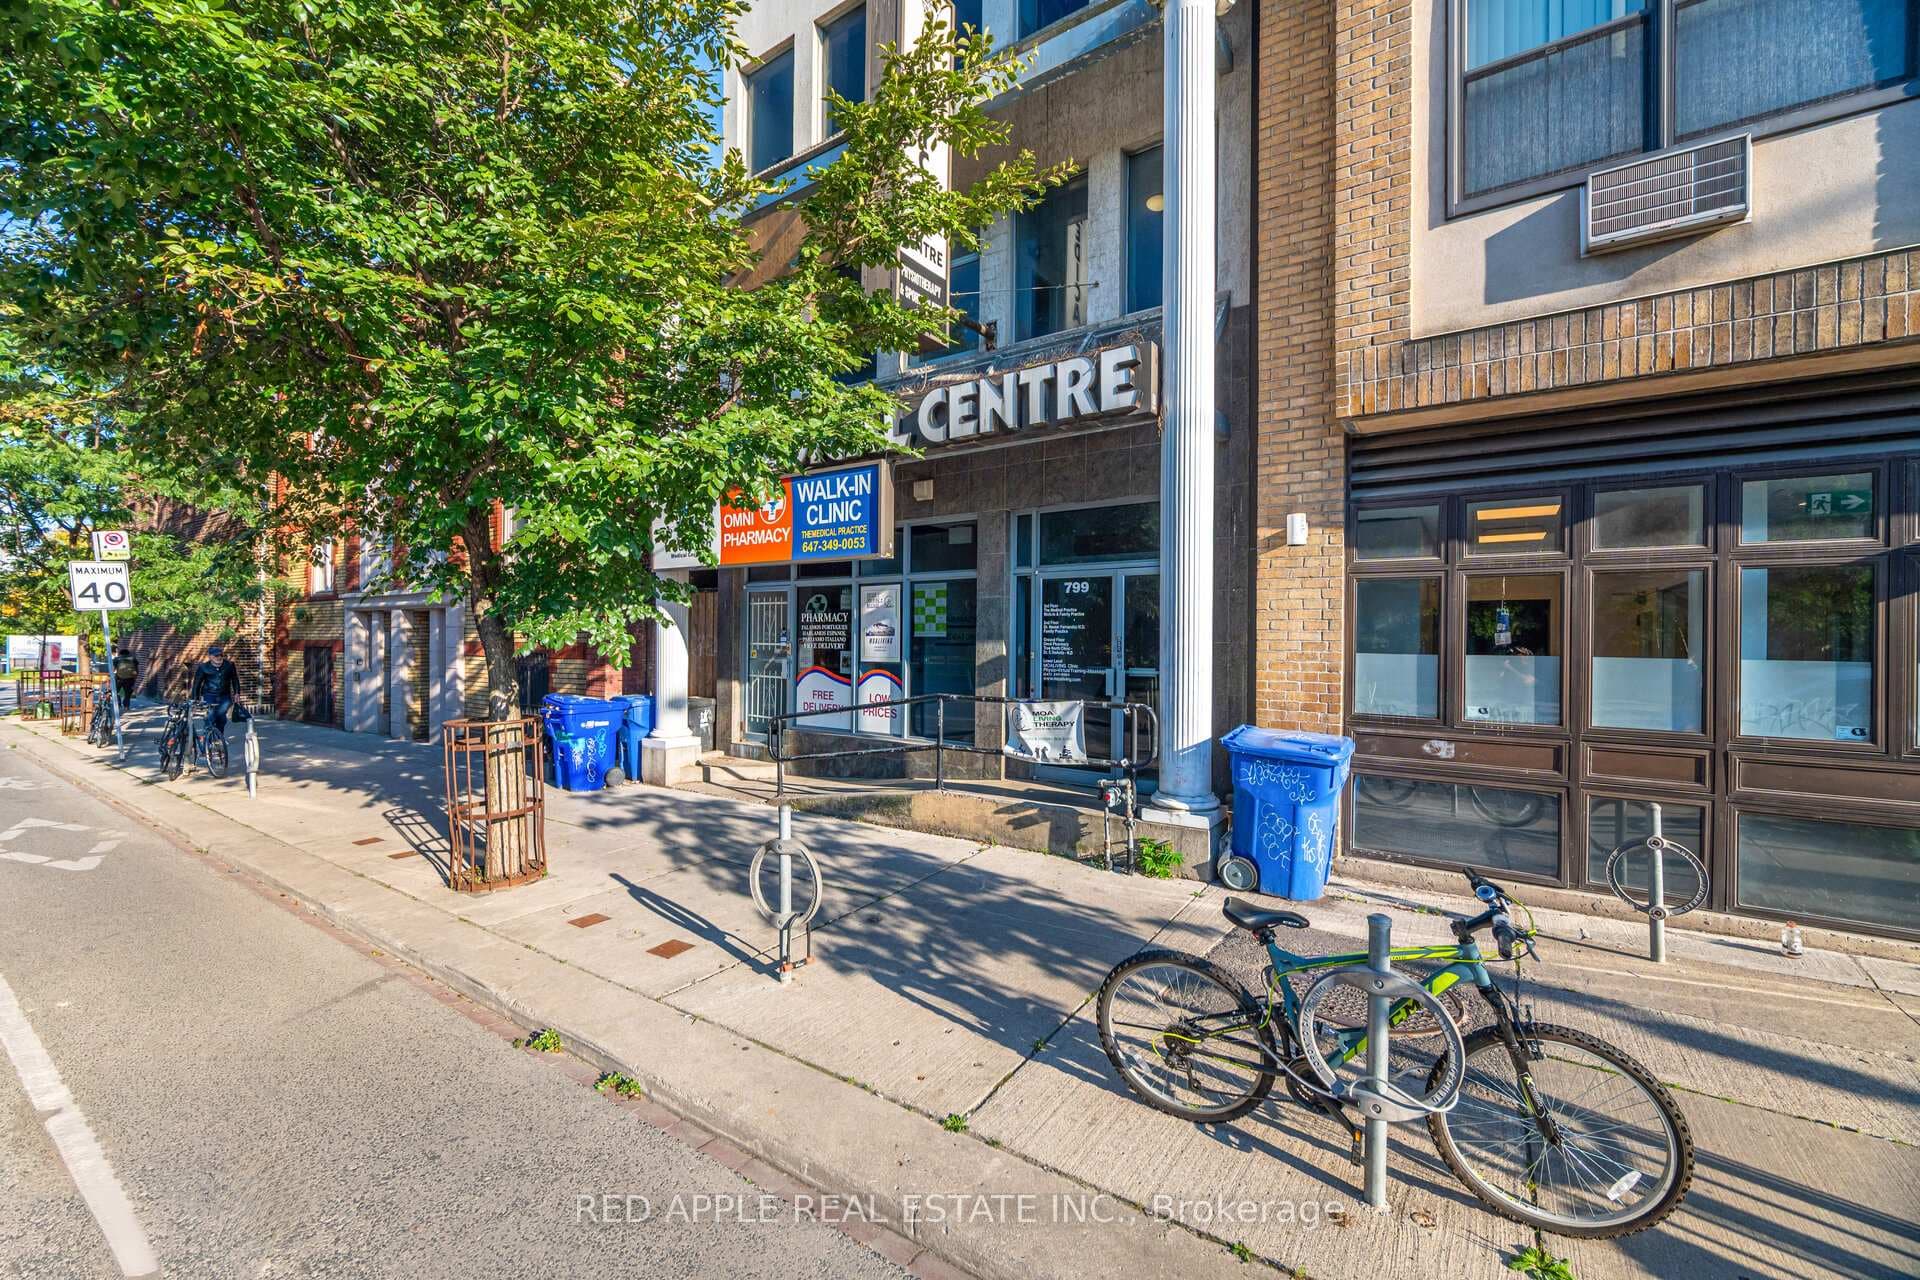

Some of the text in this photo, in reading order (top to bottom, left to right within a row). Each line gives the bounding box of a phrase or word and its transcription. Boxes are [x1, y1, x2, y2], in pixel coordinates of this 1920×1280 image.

[918, 344, 1142, 443] CENTRE
[797, 472, 871, 503] WALK-IN
[806, 500, 862, 525] CLINIC
[723, 512, 754, 529] OMNI
[838, 524, 868, 536] PRACTICE
[723, 527, 791, 548] PHARMACY
[802, 537, 865, 553] 647-349-0053
[75, 567, 123, 575] MAXIMUM
[78, 581, 126, 604] 40
[1064, 582, 1090, 594] 799
[801, 612, 849, 623] PHARMACY
[812, 690, 834, 700] FREE
[869, 693, 892, 704] LOW
[803, 702, 844, 714] DELIVERY
[863, 707, 897, 719] PRICES
